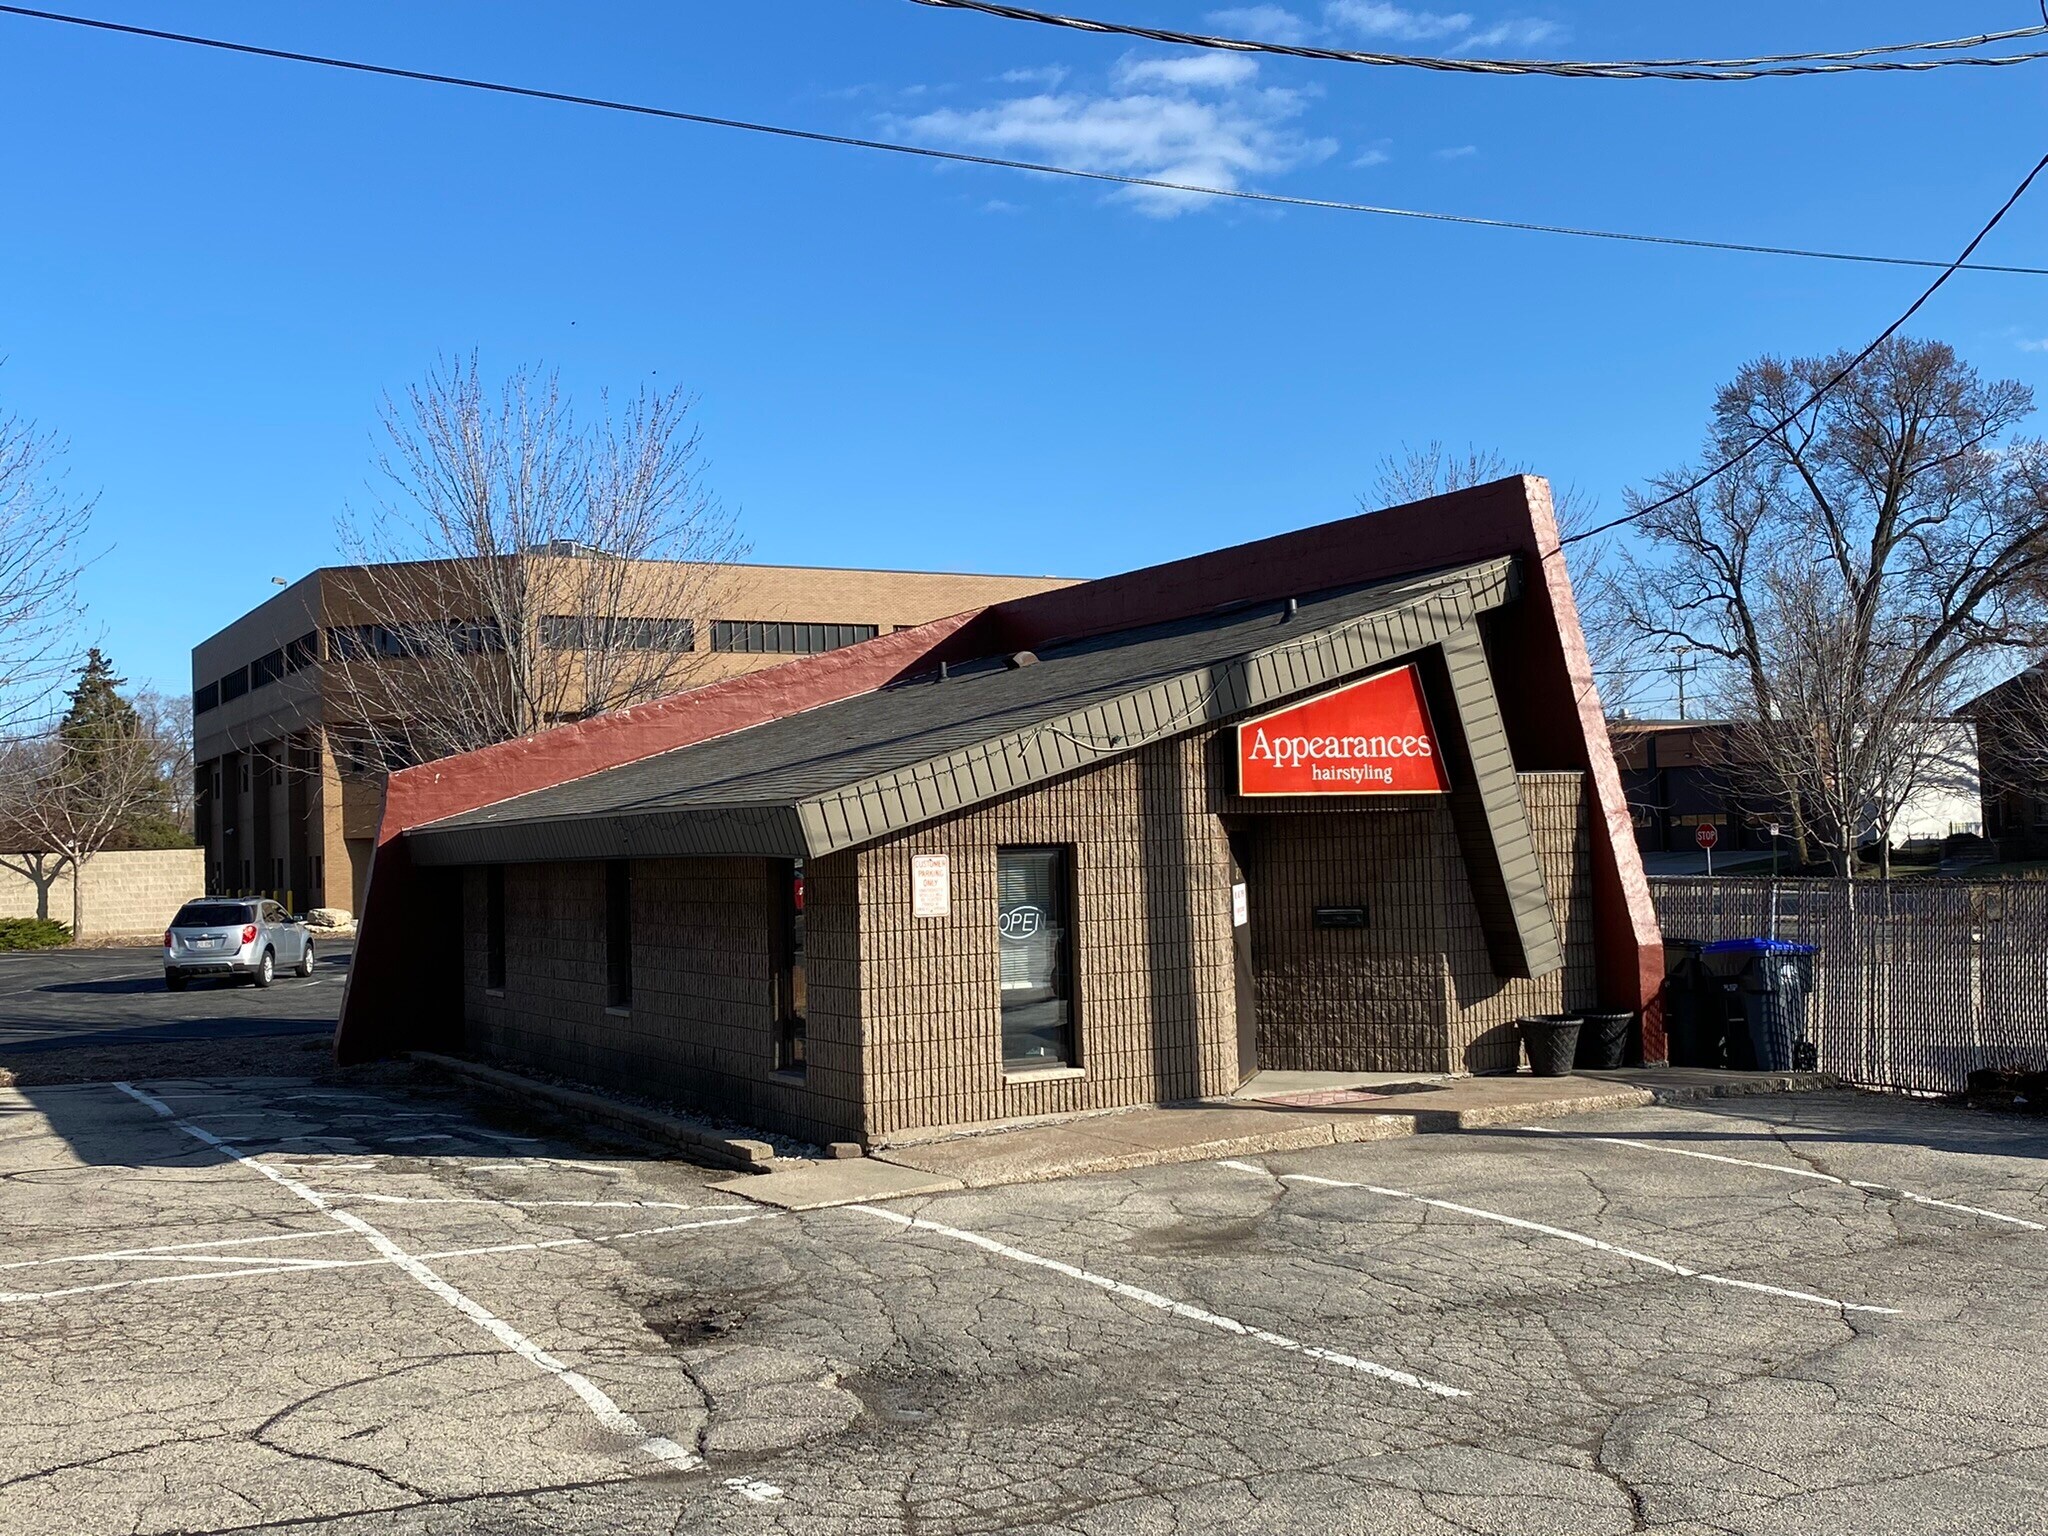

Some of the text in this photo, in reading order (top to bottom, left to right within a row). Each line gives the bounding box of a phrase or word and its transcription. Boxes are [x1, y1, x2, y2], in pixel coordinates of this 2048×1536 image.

[1248, 727, 1432, 767] Appearances
[1311, 764, 1393, 784] hairstyling
[1697, 830, 1716, 841] STOP
[915, 860, 946, 868] CUSTOMER
[999, 912, 1046, 931] OPEN
